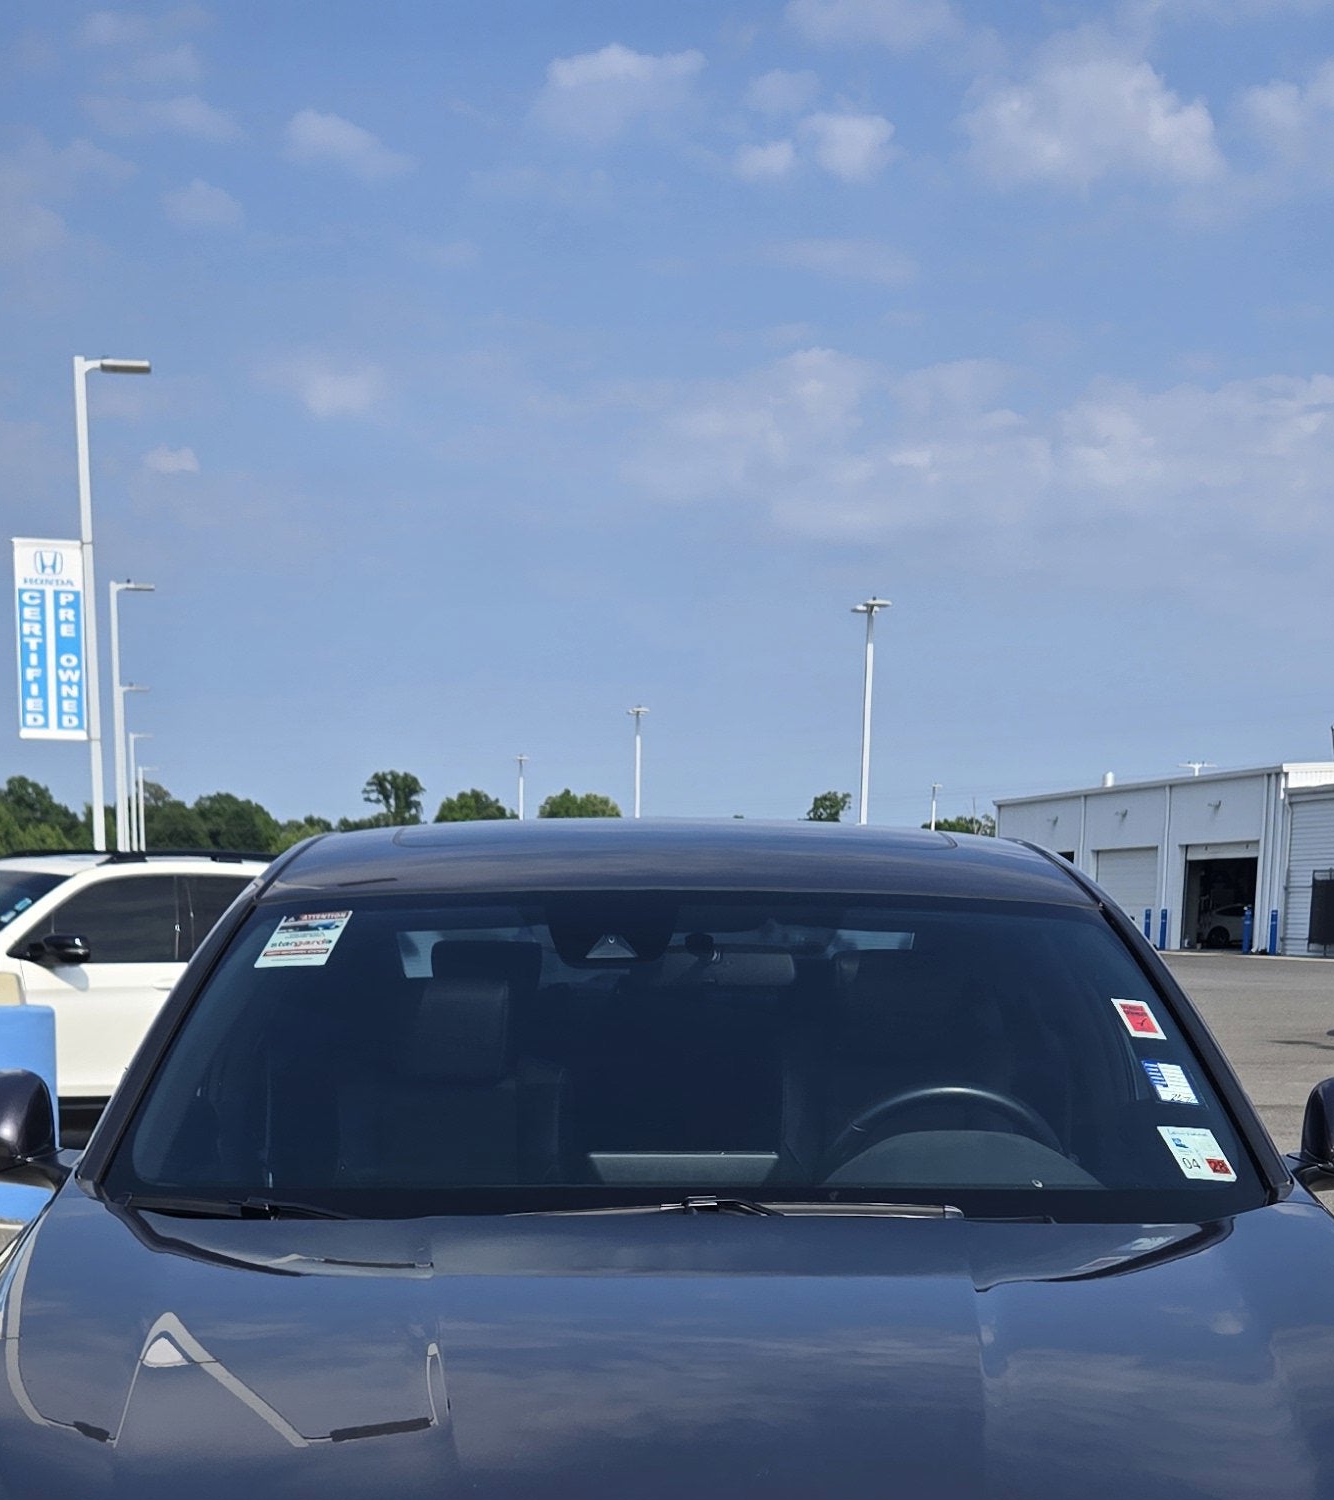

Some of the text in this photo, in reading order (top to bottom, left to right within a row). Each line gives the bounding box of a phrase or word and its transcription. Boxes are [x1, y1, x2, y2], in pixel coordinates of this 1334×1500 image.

[23, 577, 75, 587] HONDA
[21, 591, 45, 727] CERTIFIED
[58, 593, 80, 728] PRE OWNED
